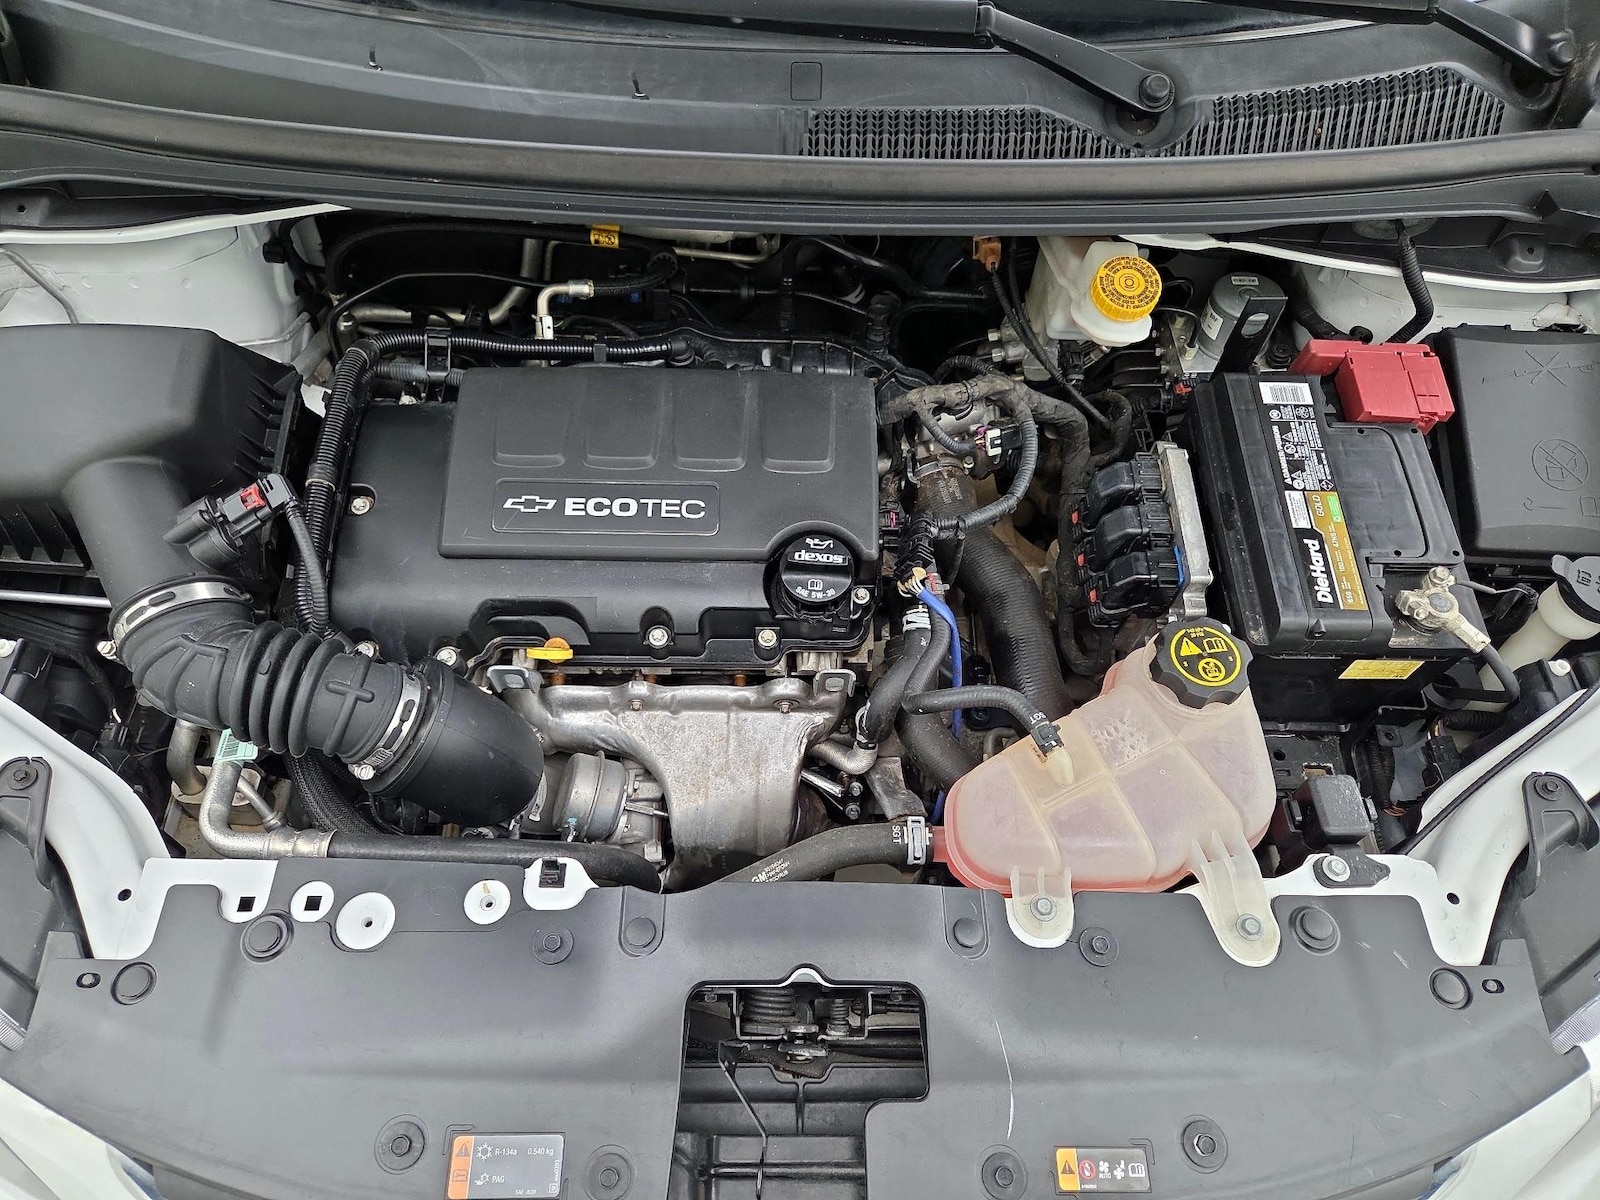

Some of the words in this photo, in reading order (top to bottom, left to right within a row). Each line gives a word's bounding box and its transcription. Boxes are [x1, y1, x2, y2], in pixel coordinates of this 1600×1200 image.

[564, 497, 706, 520] ECOTEC
[1312, 494, 1325, 517] GOLD
[794, 549, 845, 564] dexos
[1303, 538, 1335, 604] DieHard
[795, 586, 810, 598] SAE
[811, 588, 836, 599] 5W-30
[1346, 590, 1354, 604] 650
[892, 825, 902, 844] SGT
[751, 871, 768, 883] GM
[494, 1148, 518, 1156] R-134a
[527, 1147, 545, 1155] 0.540
[545, 1148, 554, 1157] kg
[491, 1175, 505, 1184] PAG
